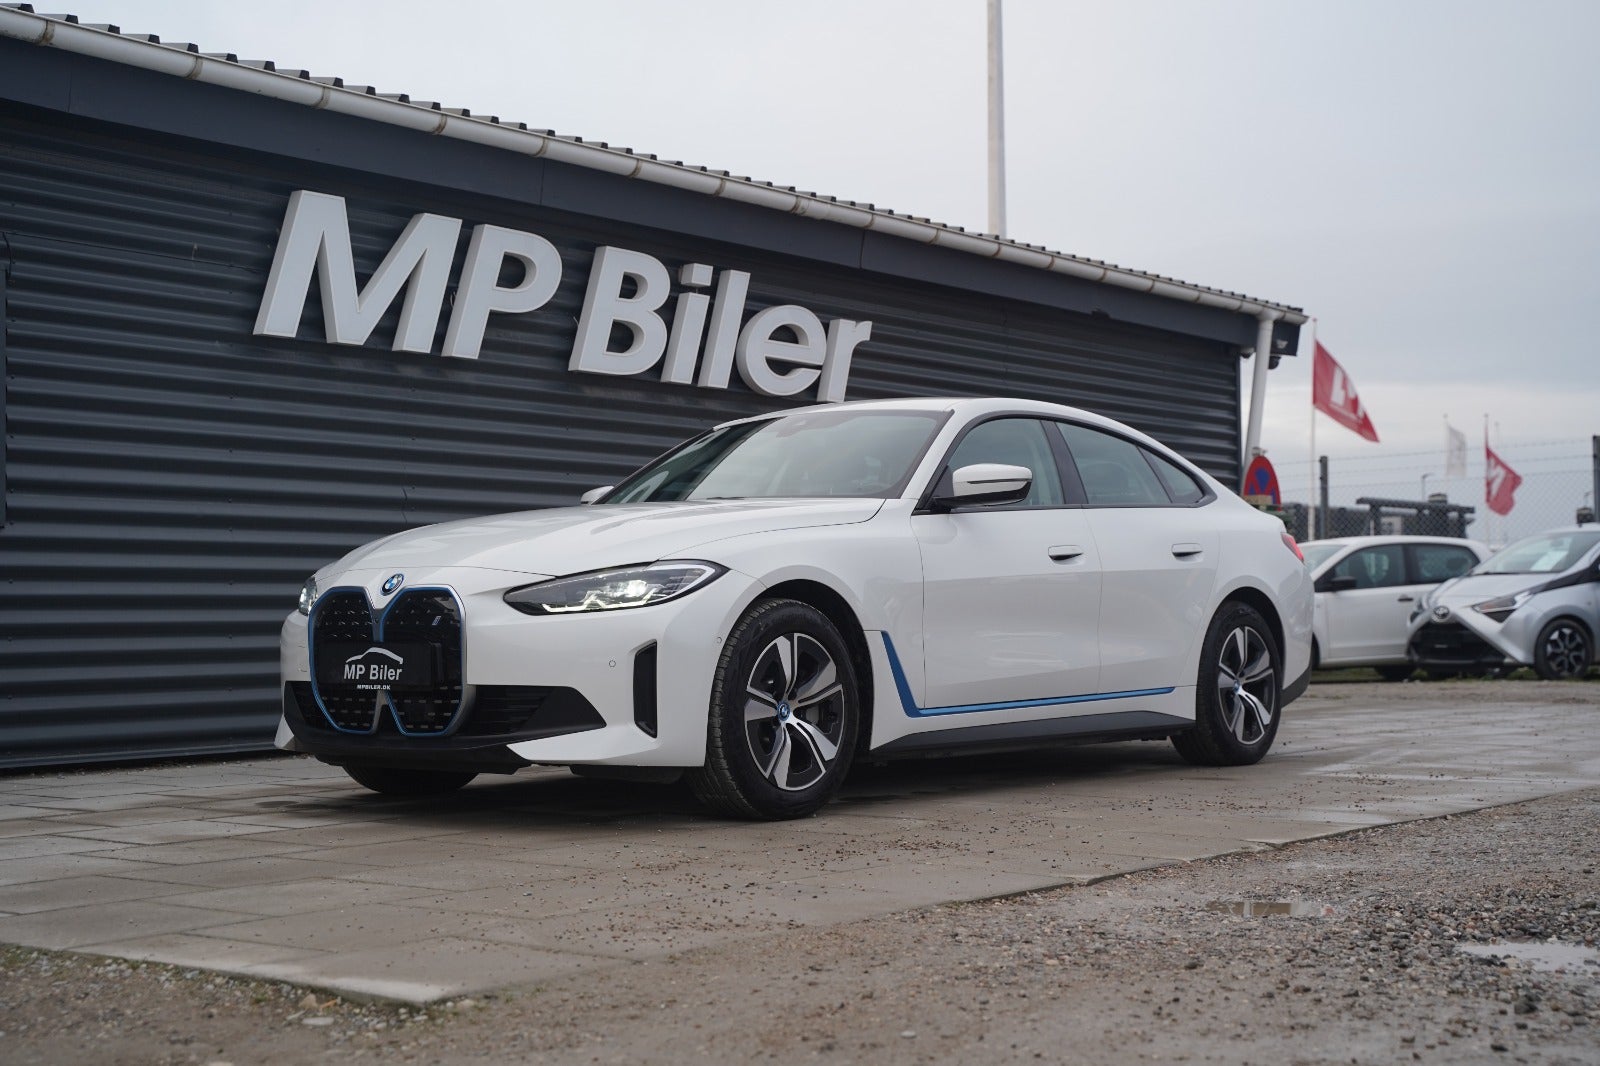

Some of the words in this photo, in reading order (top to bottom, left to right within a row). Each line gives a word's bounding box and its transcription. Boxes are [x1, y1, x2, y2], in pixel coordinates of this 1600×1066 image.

[252, 189, 563, 361] MP
[568, 245, 872, 403] Biler
[344, 664, 365, 679] MP
[369, 664, 402, 680] Biler
